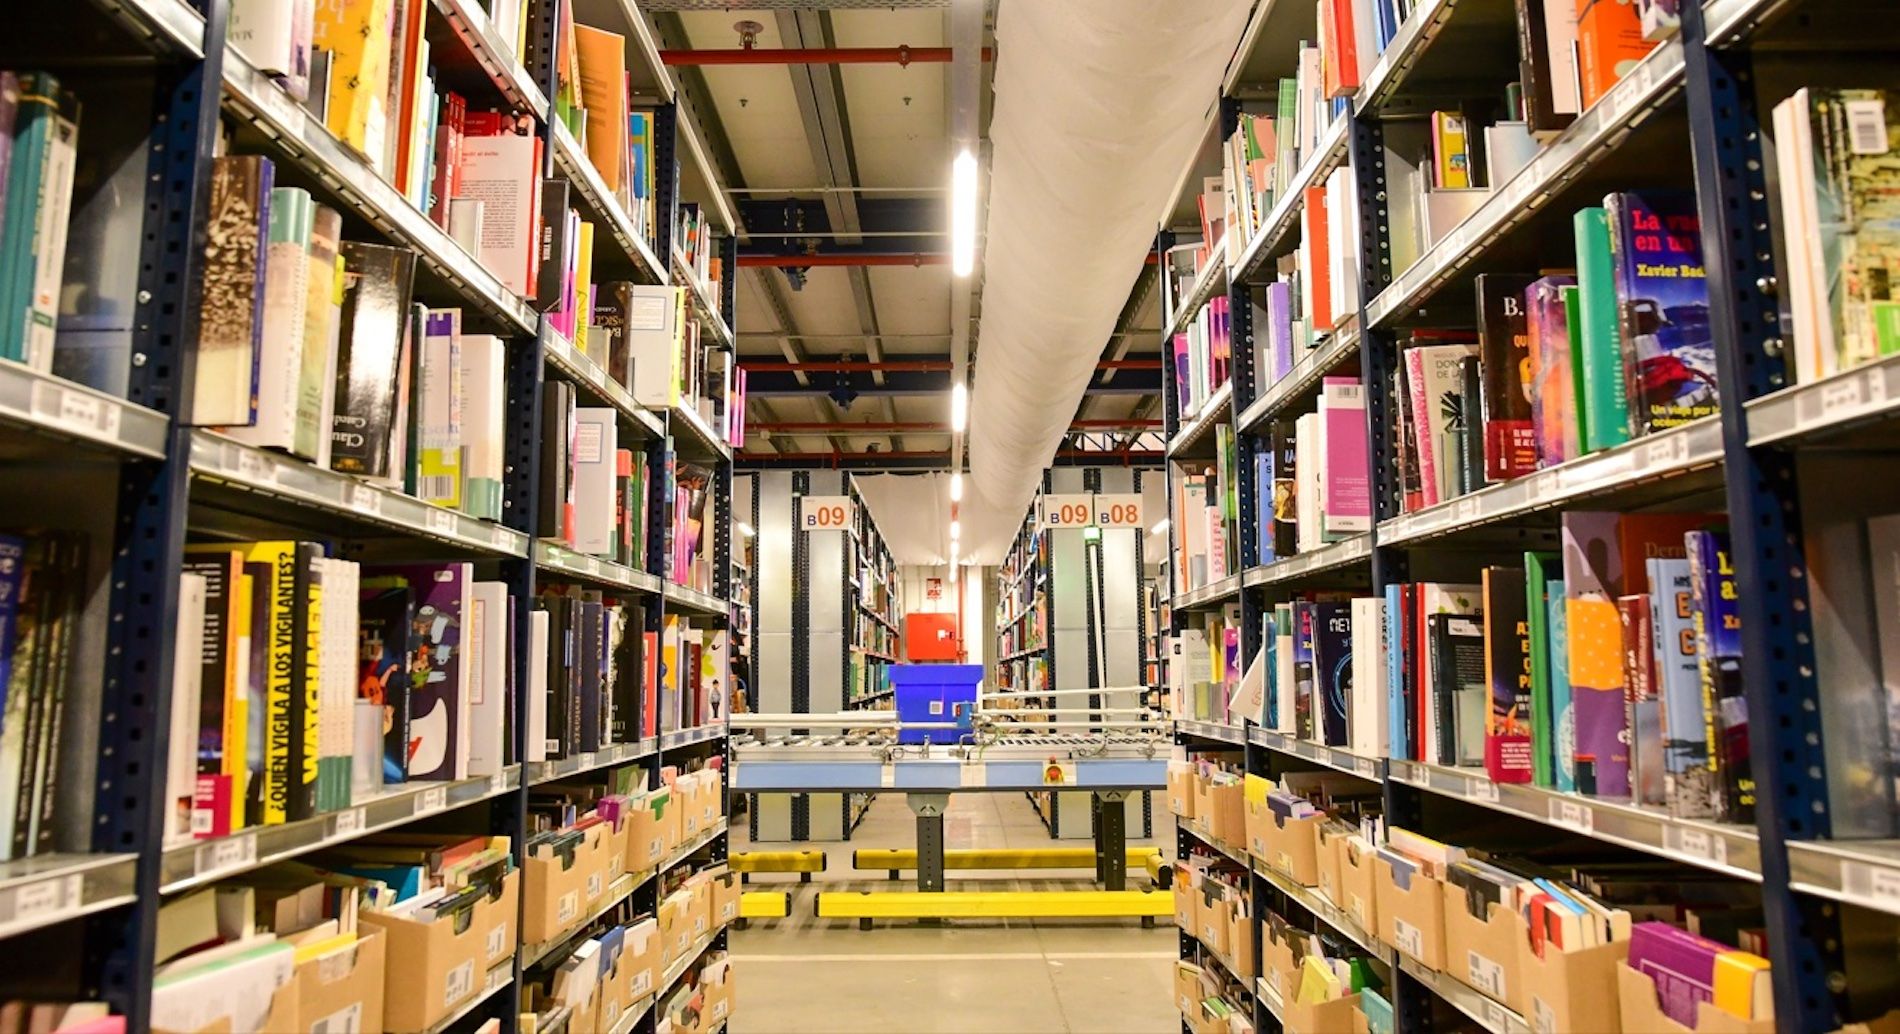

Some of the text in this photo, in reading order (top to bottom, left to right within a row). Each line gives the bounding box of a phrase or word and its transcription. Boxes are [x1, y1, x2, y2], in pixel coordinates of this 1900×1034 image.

[1632, 209, 1661, 231] La
[1635, 234, 1662, 252] en
[1637, 264, 1679, 277] Xavier
[807, 506, 845, 526] B09
[1050, 504, 1088, 524] B09
[1101, 504, 1138, 524] B08
[276, 552, 295, 648] VIGILANTES?
[274, 652, 291, 679] LOS
[274, 683, 289, 694] A
[272, 698, 289, 751] VIGILA
